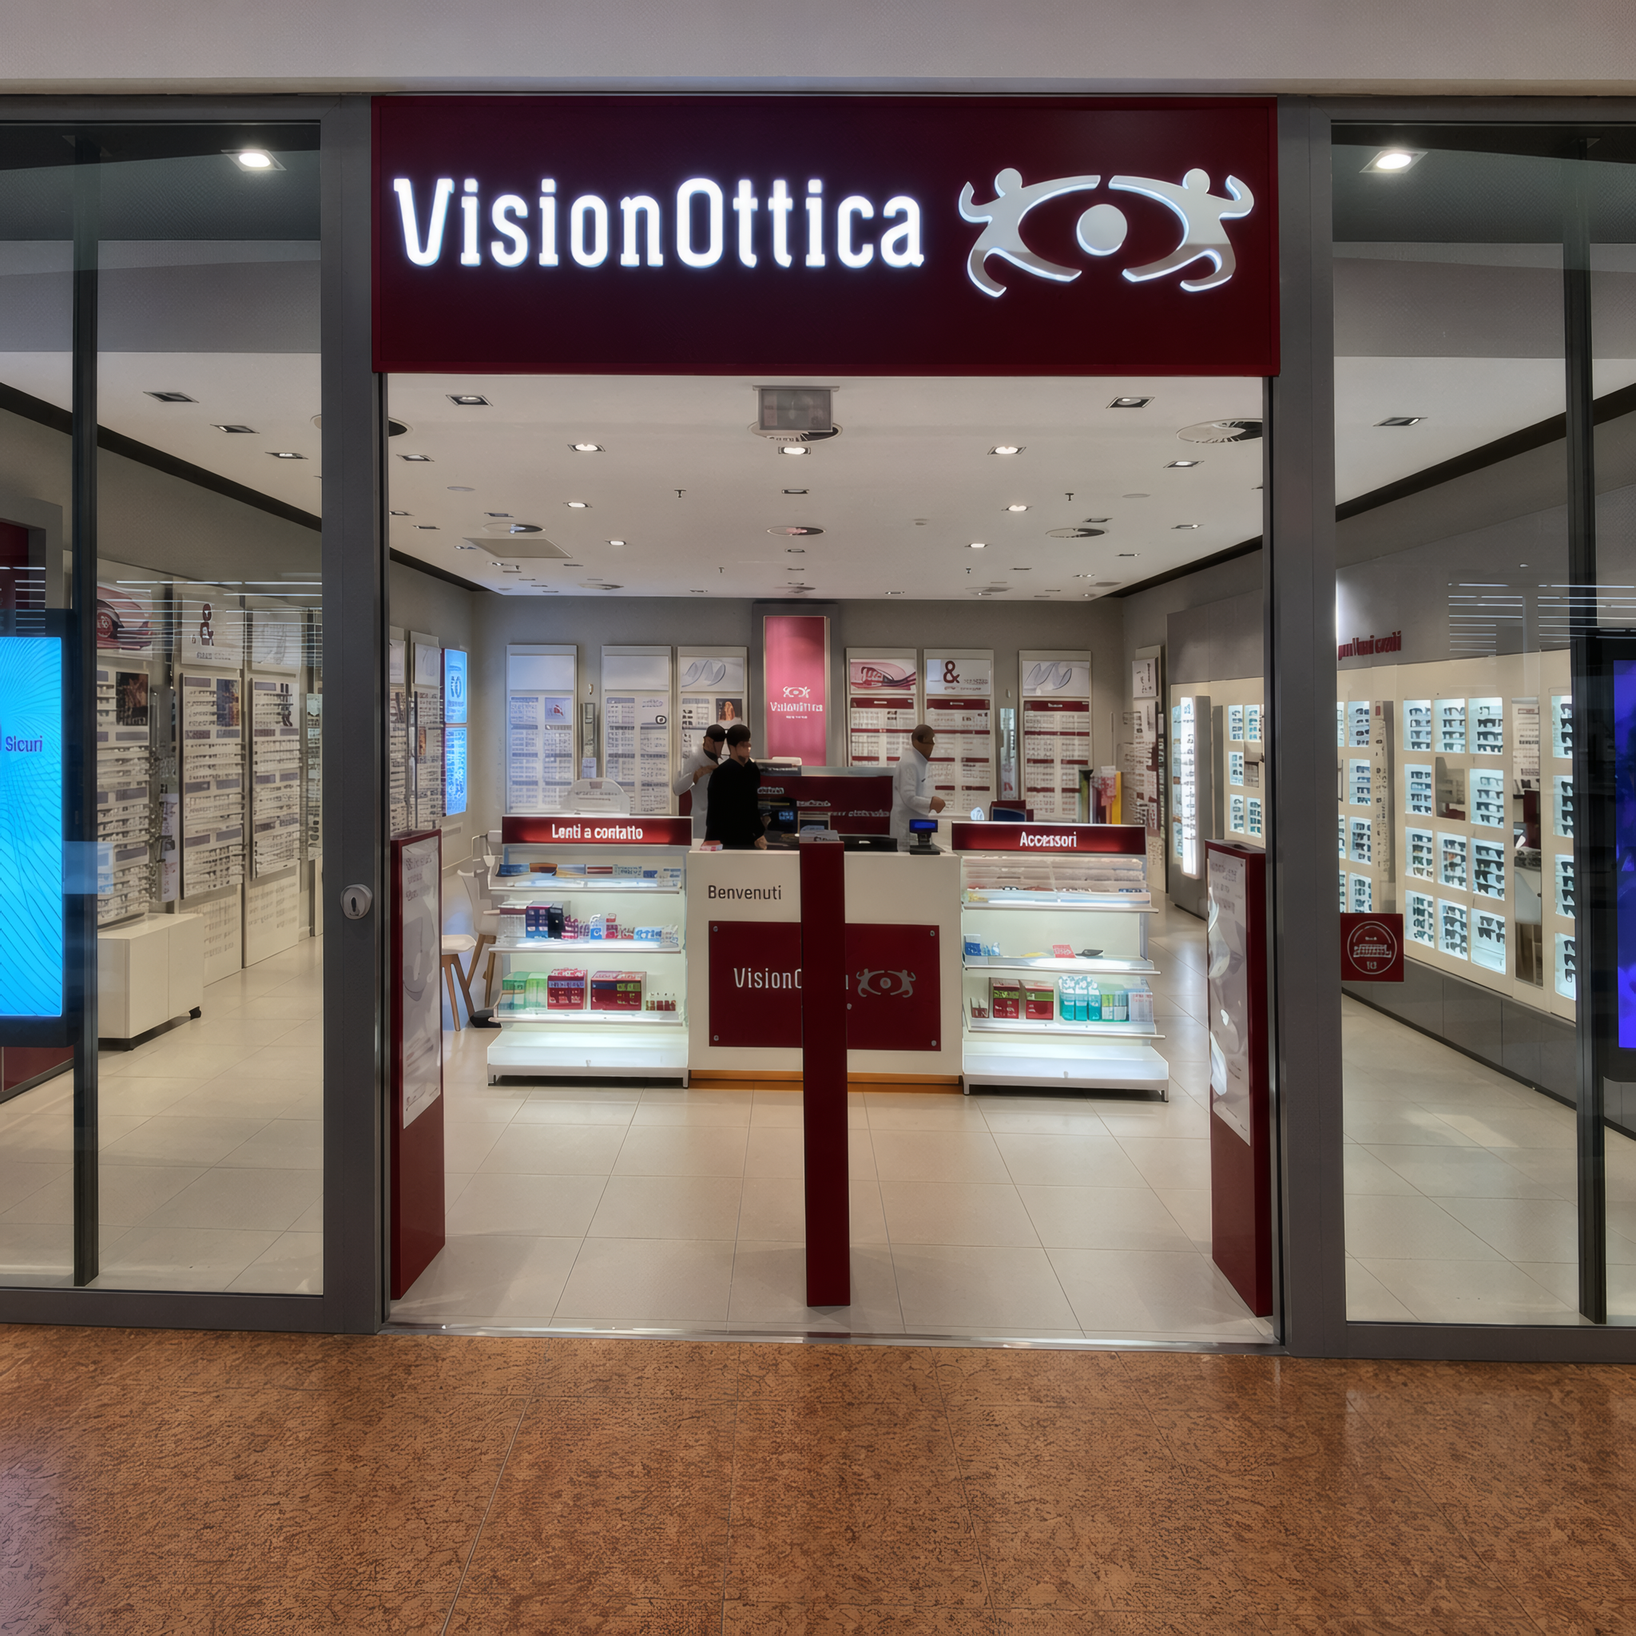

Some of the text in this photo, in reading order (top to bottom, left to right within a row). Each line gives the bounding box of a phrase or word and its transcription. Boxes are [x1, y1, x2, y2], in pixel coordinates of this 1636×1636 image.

[393, 177, 925, 269] VisionOttica
[5, 736, 43, 752] Sicuri
[551, 823, 644, 840] Lenti a contatto
[1019, 831, 1077, 848] Accessori
[708, 884, 782, 900] Benvenuti
